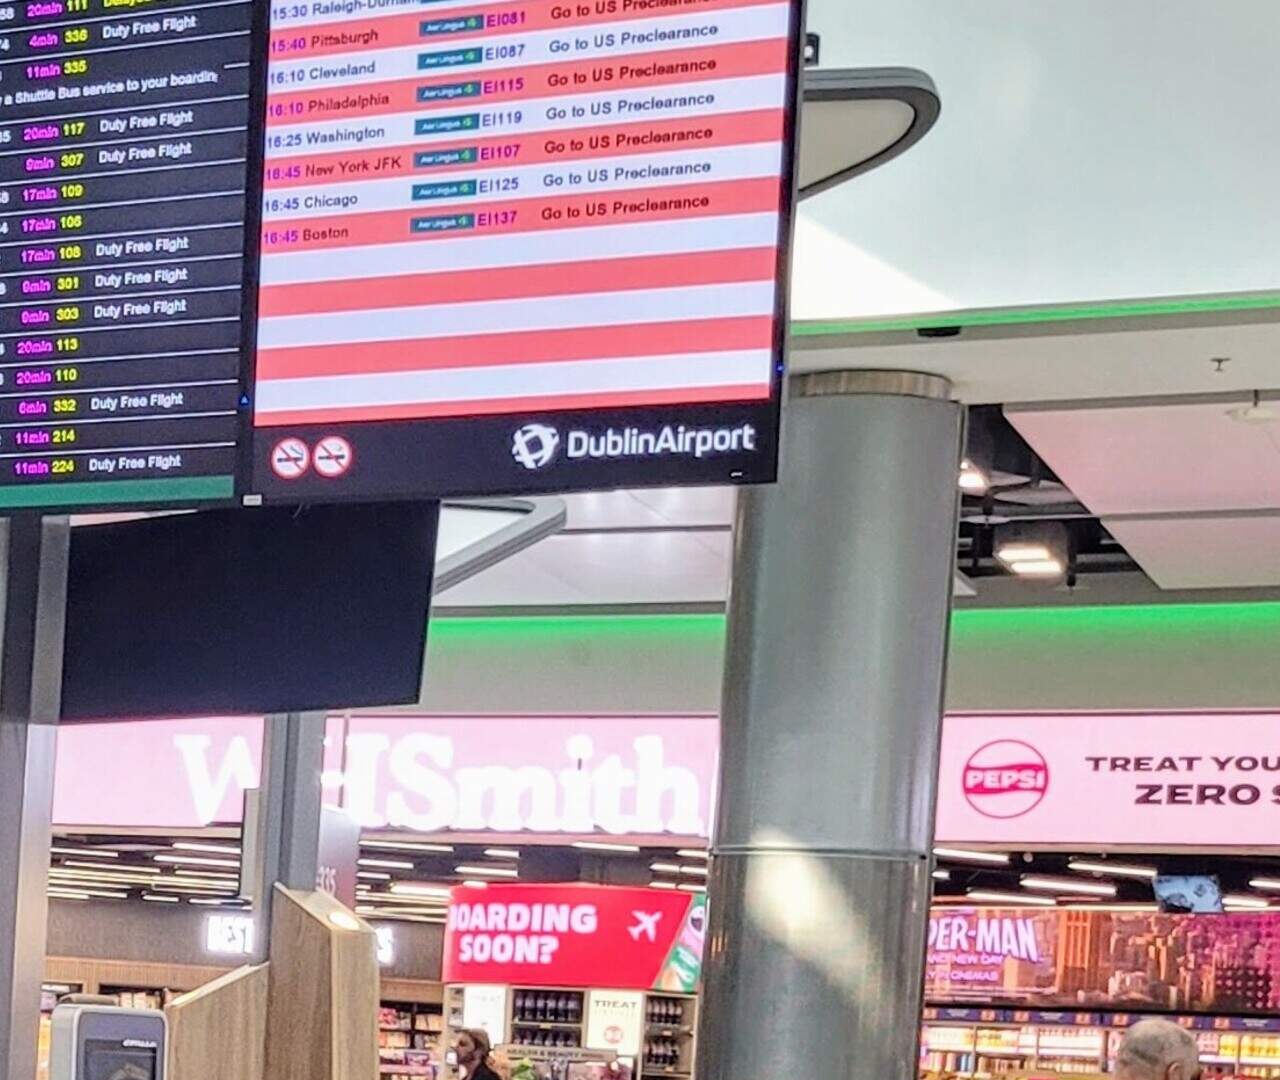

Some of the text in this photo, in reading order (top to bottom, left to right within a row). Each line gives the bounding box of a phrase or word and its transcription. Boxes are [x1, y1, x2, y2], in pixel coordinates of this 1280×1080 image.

[273, 6, 308, 20] 15:30
[272, 38, 306, 52] 15:40
[311, 29, 379, 48] Pittsburgh
[270, 25, 718, 84] 16:10 Cleveland EI087 Go to US Preclearance
[269, 59, 717, 117] 16:10 Philadelphia EI115 Go to US Preclearance
[268, 94, 715, 148] 16:25 Washington EI119 Go to US Preclearance
[266, 128, 713, 180] 16:45 New York JFK EI107 Go to US Preclearance
[265, 162, 711, 212] 16:45 Chicago EI125 Go to US Preclearance
[264, 196, 710, 244] 16:45 Boston EI137 Go to US Preclearance
[58, 277, 79, 290] 301
[95, 274, 122, 288] Duty
[125, 272, 152, 284] Free
[155, 268, 188, 283] Flight
[56, 307, 79, 320] 303
[57, 338, 78, 351] 113
[53, 429, 75, 443] 214
[567, 423, 756, 457] DublinAirport
[52, 460, 74, 473] 224
[1086, 756, 1202, 772] TREAT
[966, 768, 1047, 790] PEPSI
[1135, 784, 1261, 806] ZERO
[459, 934, 560, 964] SOON?
[928, 916, 1038, 962] DER-MAN
